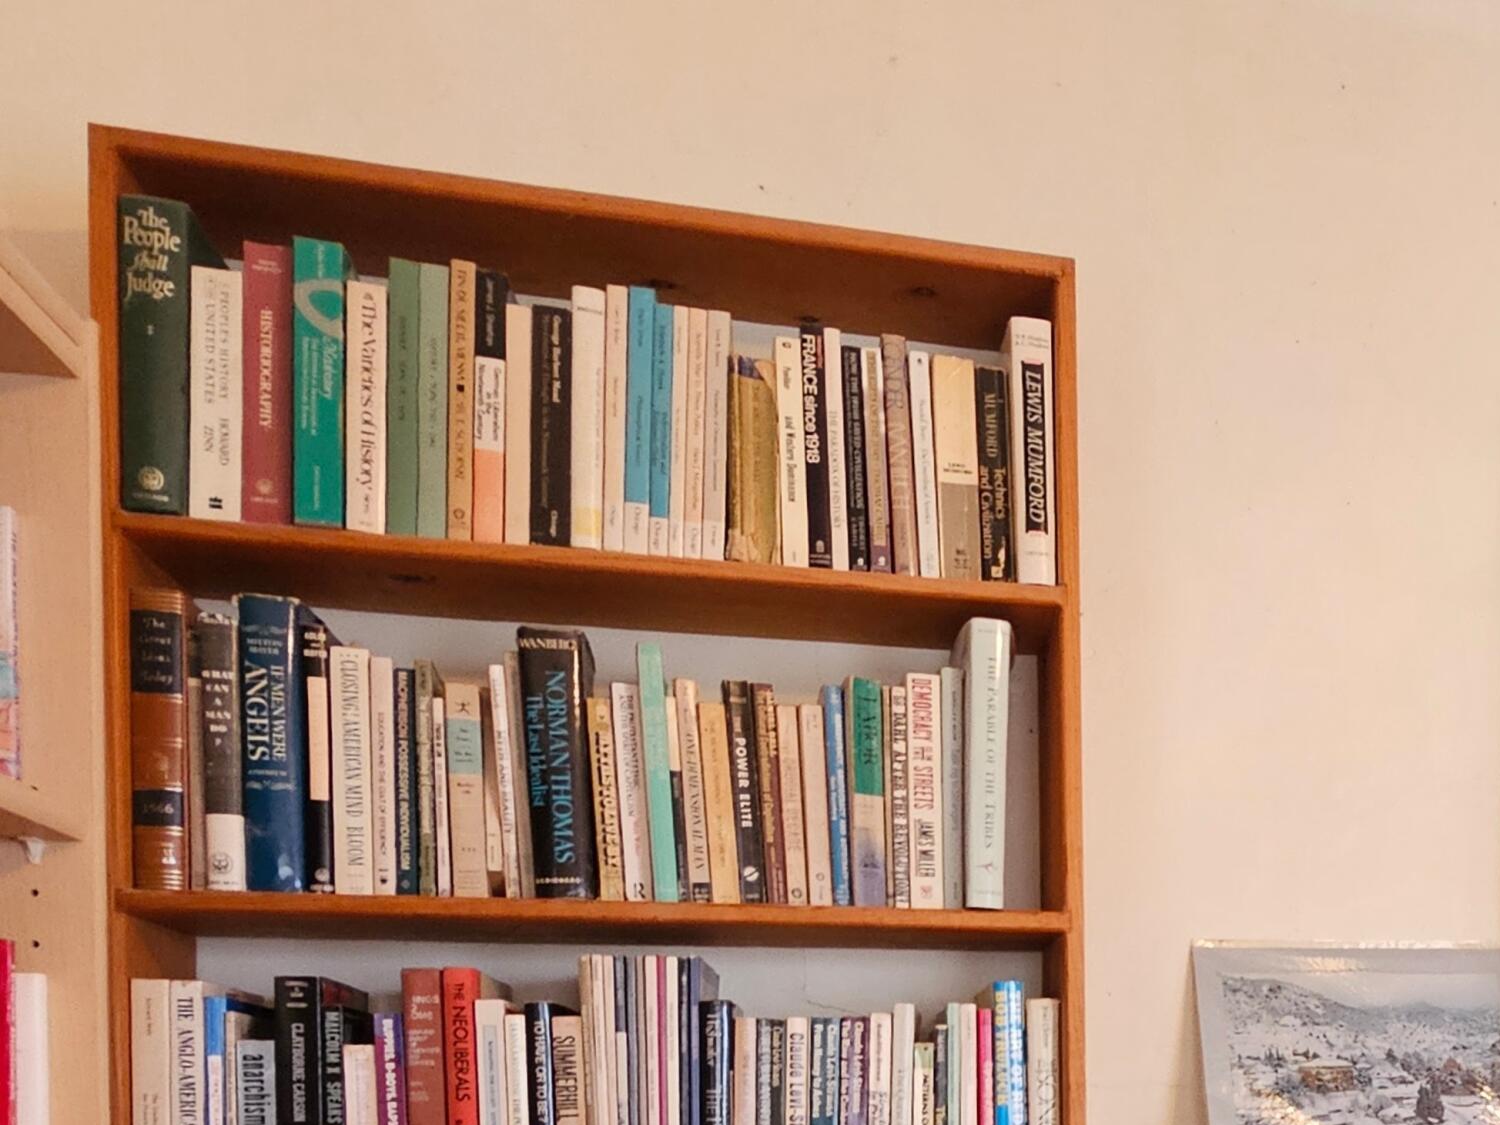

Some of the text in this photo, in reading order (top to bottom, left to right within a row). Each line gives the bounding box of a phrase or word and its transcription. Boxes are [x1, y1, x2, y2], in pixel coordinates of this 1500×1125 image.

[122, 216, 182, 252] People
[137, 206, 169, 228] The
[127, 271, 176, 299] Judge
[204, 303, 216, 404] UNITED STATES
[219, 348, 231, 400] HISTORY
[258, 310, 272, 428] HISTORIOGRAPHY
[355, 302, 377, 491] The Varieties of History
[802, 334, 820, 463] FRANCE since 1918
[203, 425, 215, 453] ZINN
[219, 418, 230, 466] HOWARD
[984, 392, 998, 458] MUMFORD
[1024, 370, 1046, 523] LEWIS MUMFORD
[979, 466, 994, 559] and Civilization
[994, 465, 1006, 519] Technics
[244, 661, 269, 760] ANGELS
[271, 665, 286, 762] IF MEN WERE
[526, 693, 546, 807] The Last Idealist
[911, 678, 934, 810] DEMOCRACY STREETS
[340, 660, 365, 867] CLOSING AMERICAN MIND BLOOM
[544, 671, 575, 863] NORMAN THOMAS
[735, 738, 752, 827] POWER ELITE
[917, 819, 936, 878] JAMES MILLER
[177, 997, 194, 1021] THE
[452, 983, 469, 1102] THE NEOLIBERALS
[790, 1033, 804, 1078] Claude
[242, 1054, 270, 1125] anarchism
[291, 1022, 306, 1122] CLAYBORNE CARSON
[325, 1012, 342, 1124] MALCOLM X SPEAKS
[534, 1020, 548, 1123] TO HAVE OR TO BE?
[553, 1036, 578, 1122] SUMMERHILL
